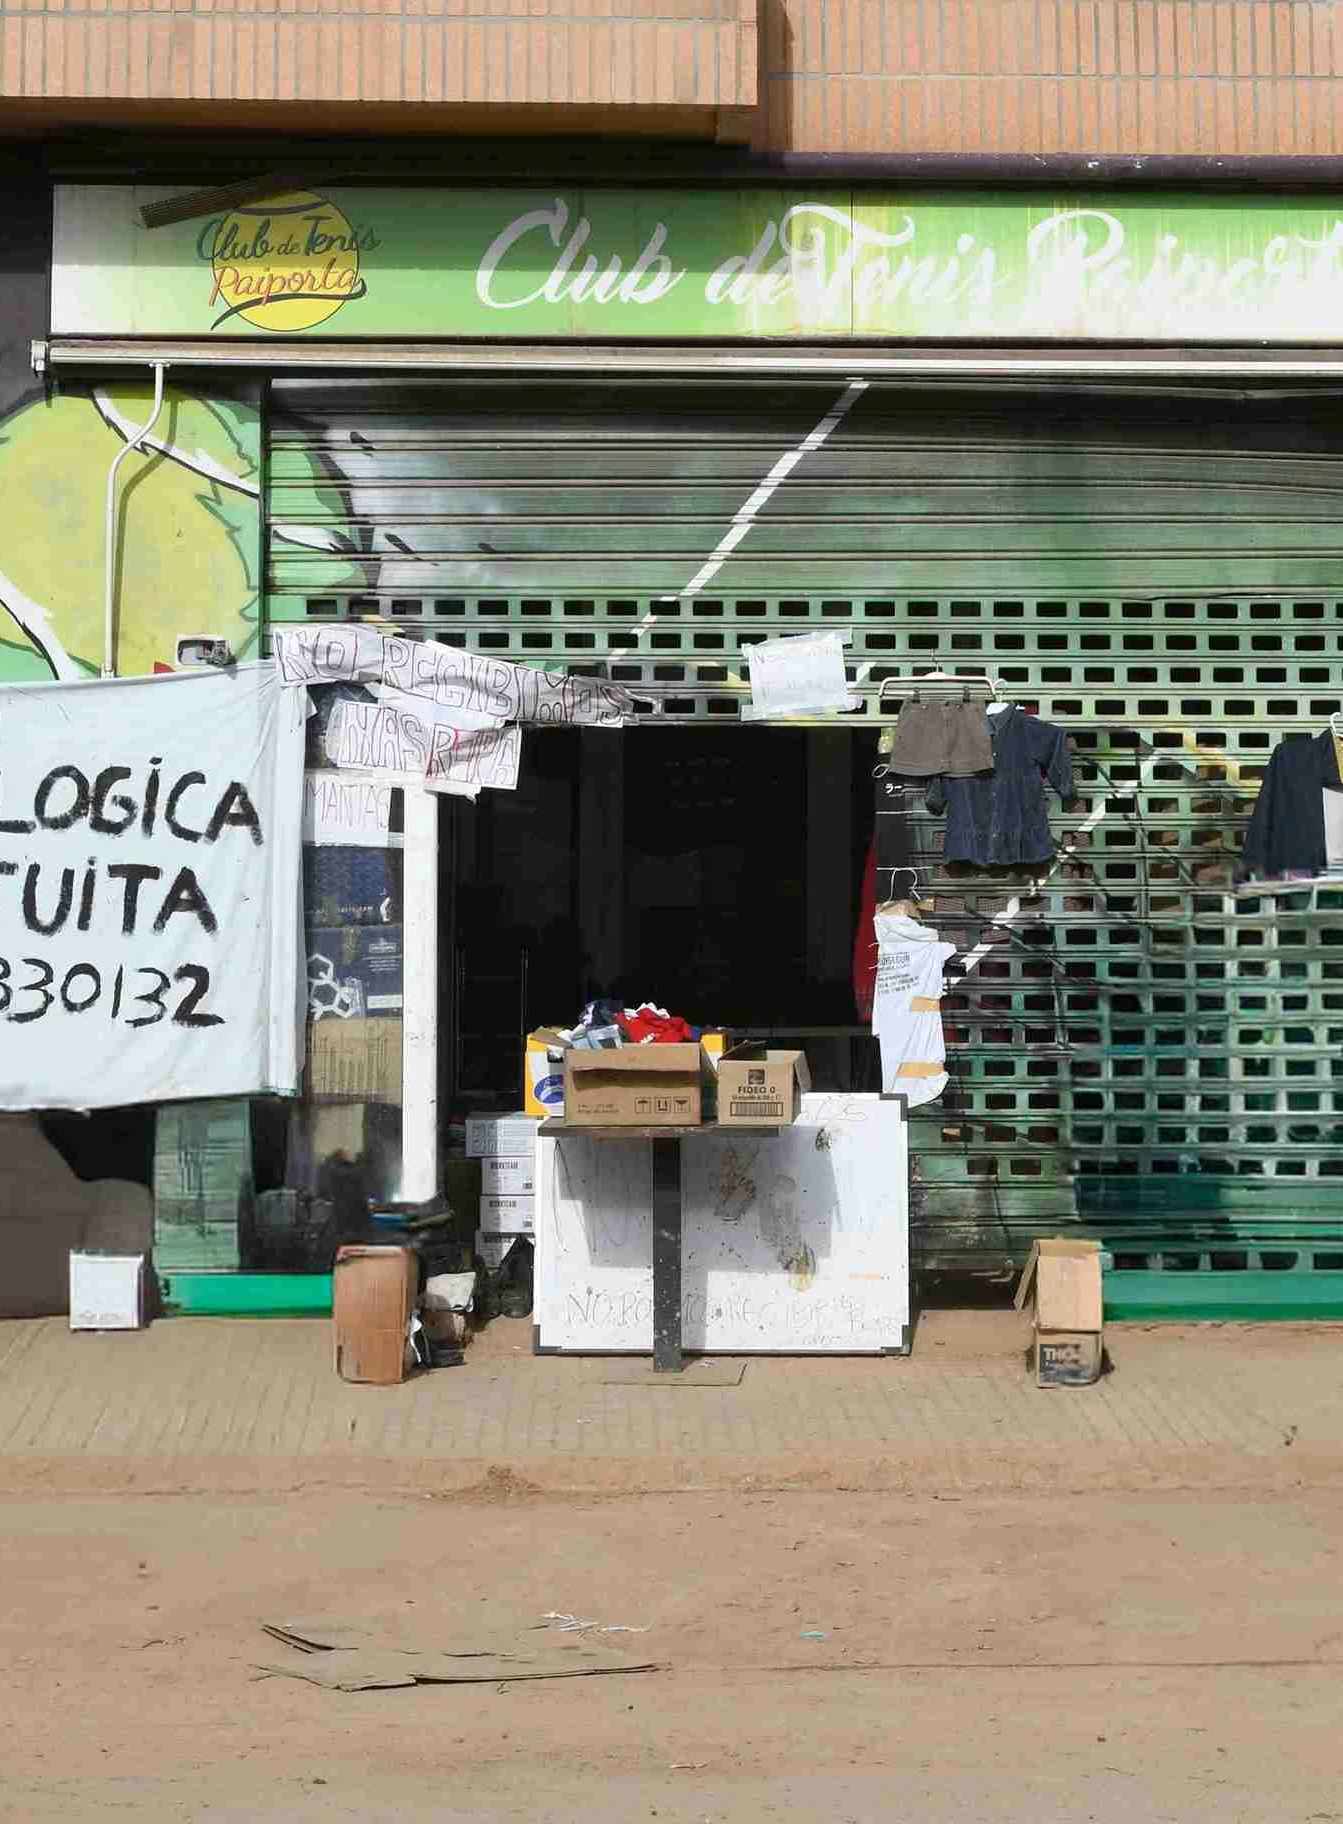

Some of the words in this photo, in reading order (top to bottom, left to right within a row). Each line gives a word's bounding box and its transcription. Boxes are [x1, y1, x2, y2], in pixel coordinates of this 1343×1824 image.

[196, 216, 276, 261] Club
[277, 233, 300, 256] de
[303, 215, 381, 257] Tenis
[474, 198, 685, 309] Club
[705, 219, 793, 305] de
[209, 257, 360, 307] Paiporta
[274, 630, 358, 682] NO
